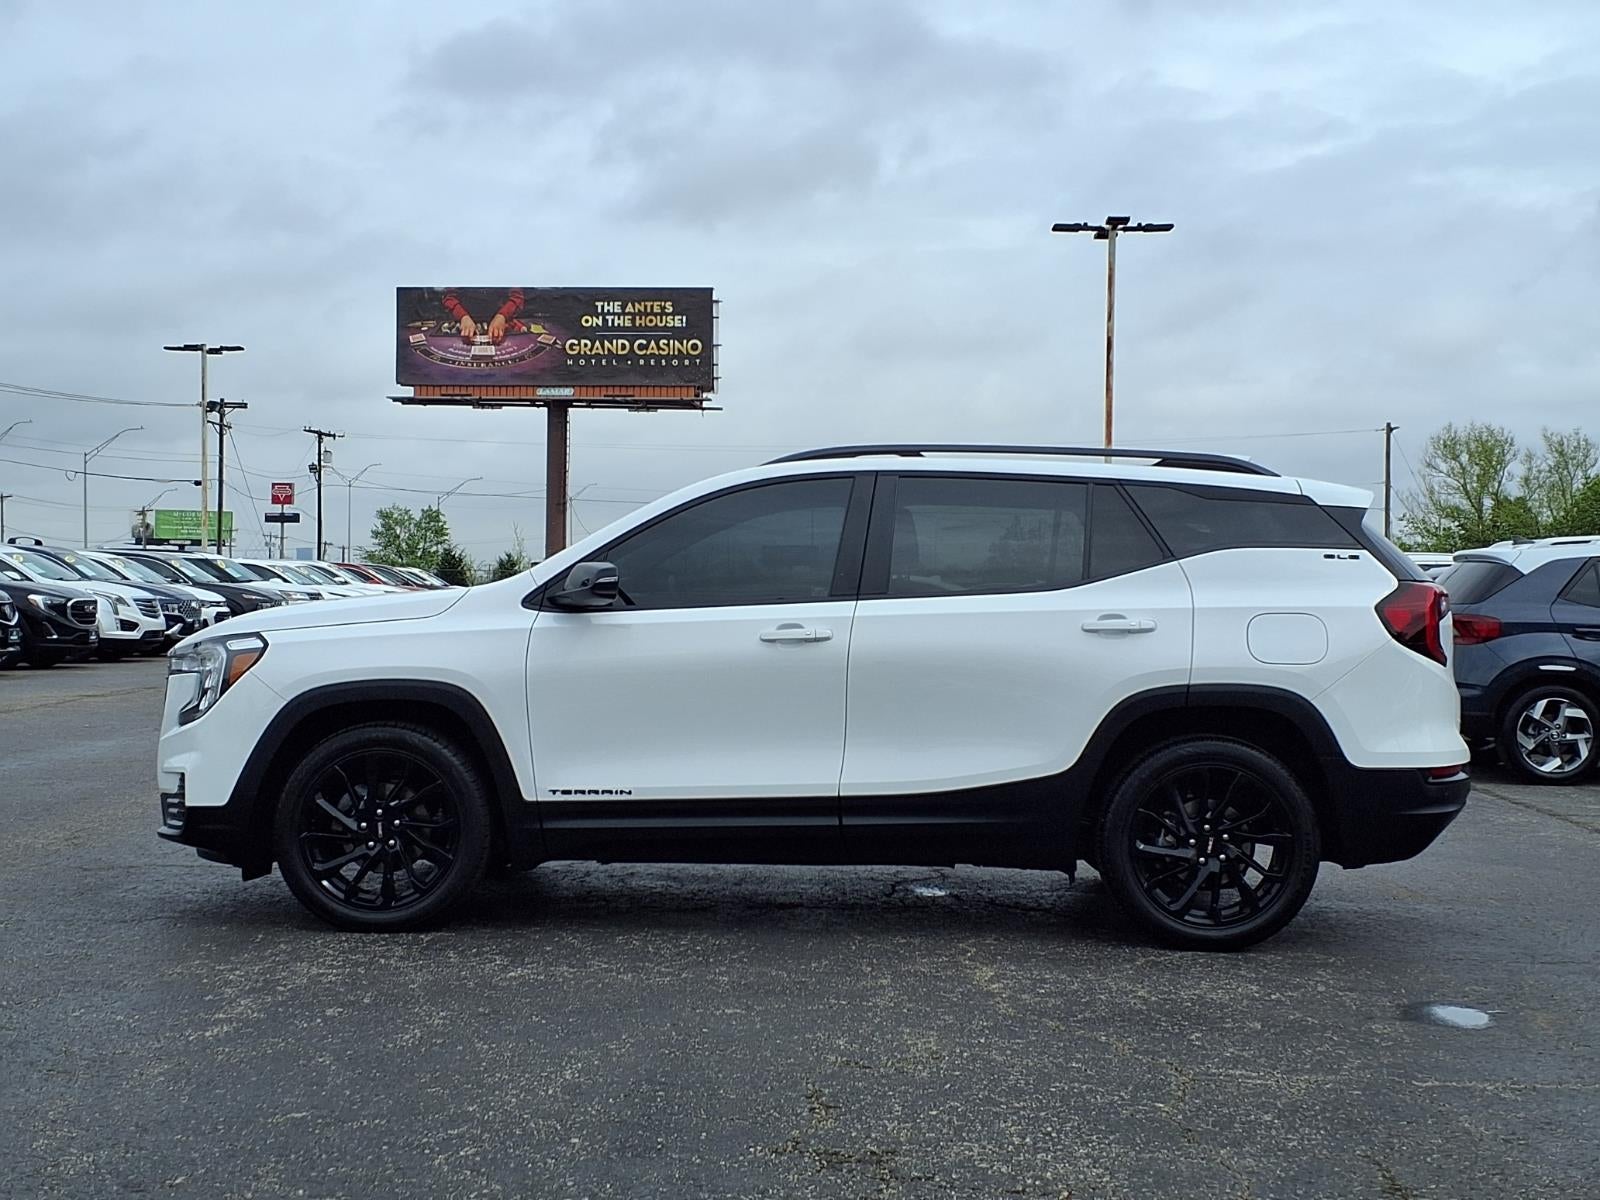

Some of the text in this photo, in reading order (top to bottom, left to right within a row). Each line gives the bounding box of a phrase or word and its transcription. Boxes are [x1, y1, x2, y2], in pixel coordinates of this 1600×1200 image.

[595, 301, 674, 313] THE ANTE'S
[581, 315, 687, 327] ON THE HOUSE!
[565, 339, 703, 355] GRAND CASINO
